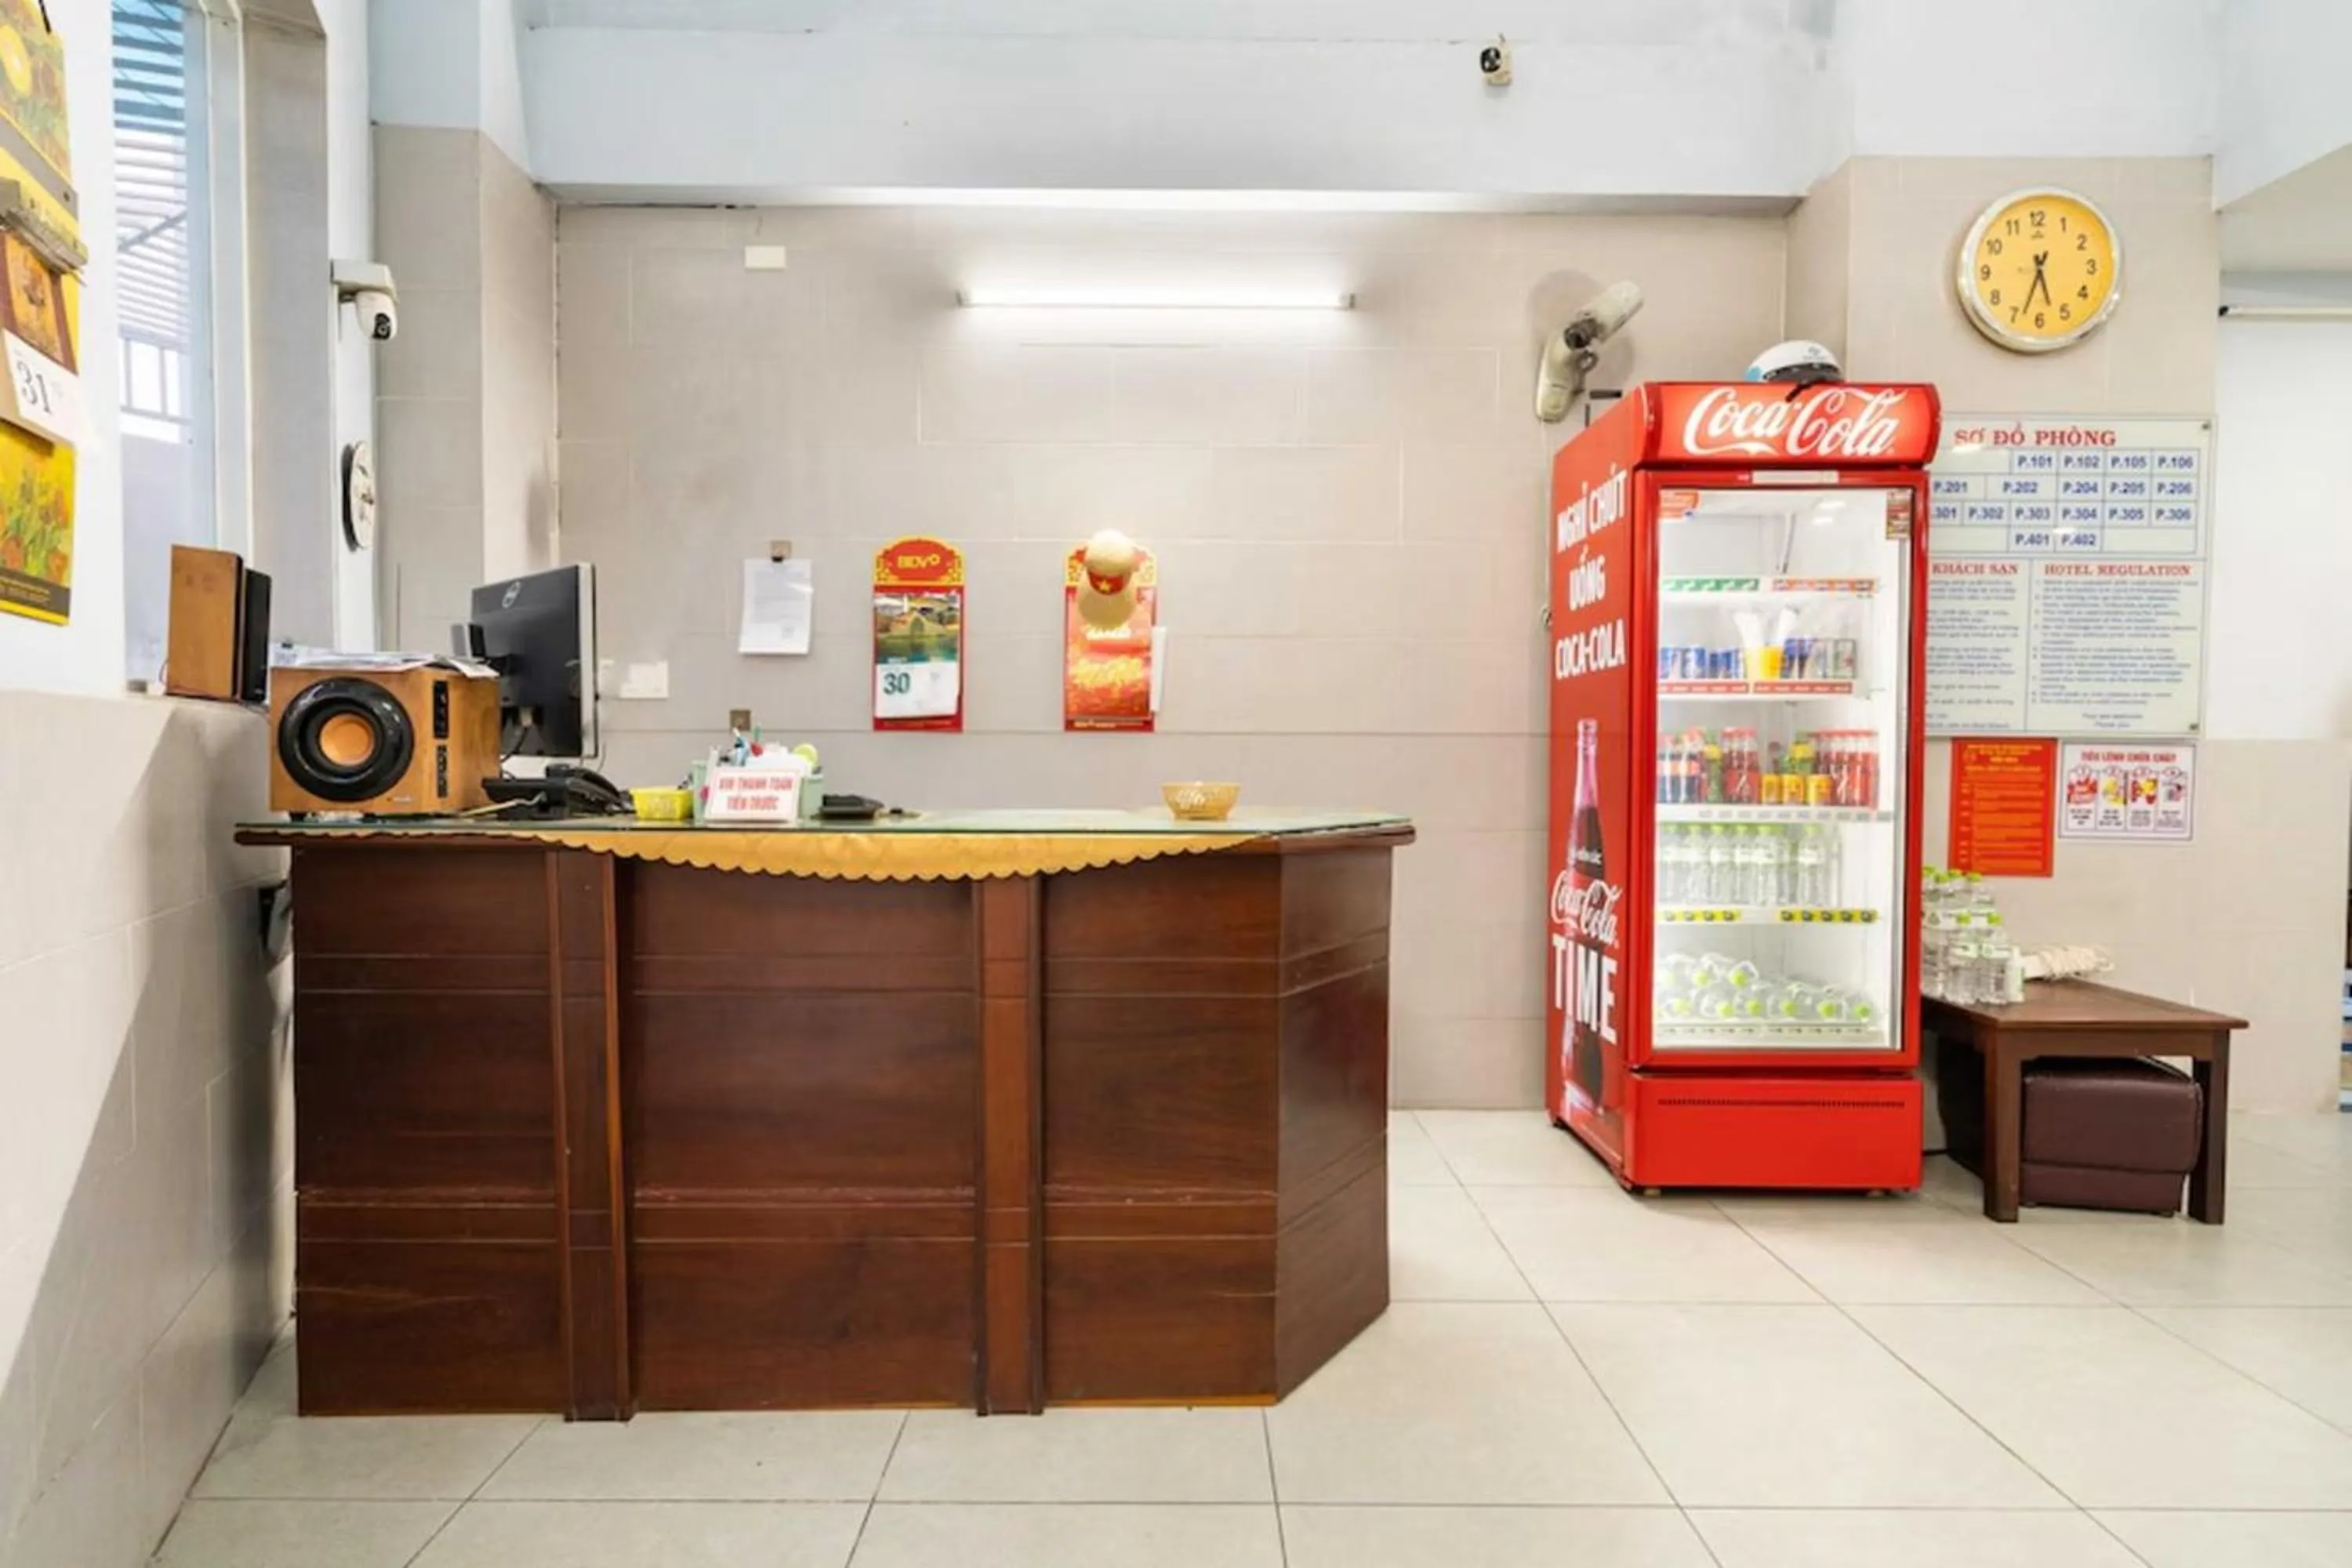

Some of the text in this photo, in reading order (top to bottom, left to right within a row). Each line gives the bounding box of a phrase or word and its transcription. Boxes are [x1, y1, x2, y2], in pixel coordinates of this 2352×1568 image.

[2030, 211, 2045, 227] 12
[2060, 217, 2067, 232] 1
[2006, 220, 2020, 235] 11
[1987, 238, 2002, 255] 10
[2077, 234, 2087, 251] 2
[1980, 264, 1991, 281] 9
[2086, 259, 2096, 275] 3
[1990, 289, 2000, 305] 8
[2078, 285, 2089, 299] 4
[2009, 307, 2020, 323] 7
[2060, 303, 2070, 321] 5
[2034, 313, 2045, 329] 6
[17, 361, 53, 415] 31
[1682, 387, 1907, 456] Coca-Cola
[2035, 425, 2116, 446] PHÒNG
[2017, 456, 2053, 468] P.101
[2064, 456, 2100, 468] P.102
[2111, 456, 2147, 469] P.105
[2158, 456, 2194, 469] P.106
[1933, 481, 1968, 493] P.201
[2003, 481, 2038, 494] P.202
[2063, 481, 2098, 494] P.204
[2109, 482, 2146, 495] P.205
[2157, 482, 2193, 495] P.206
[1931, 508, 1957, 519] .301
[1969, 507, 2004, 520] P.302
[2015, 508, 2051, 520] P.303
[2062, 508, 2098, 520] P.304
[2109, 508, 2144, 520] P.305
[2156, 508, 2192, 521] P.306
[2015, 533, 2049, 546] P.401
[2062, 533, 2096, 546] P.402
[2045, 563, 2191, 576] HOTEL REGULATION
[1555, 618, 1626, 680] COCA-COLA
[884, 672, 911, 695] 30
[1552, 933, 1617, 1045] TIME
